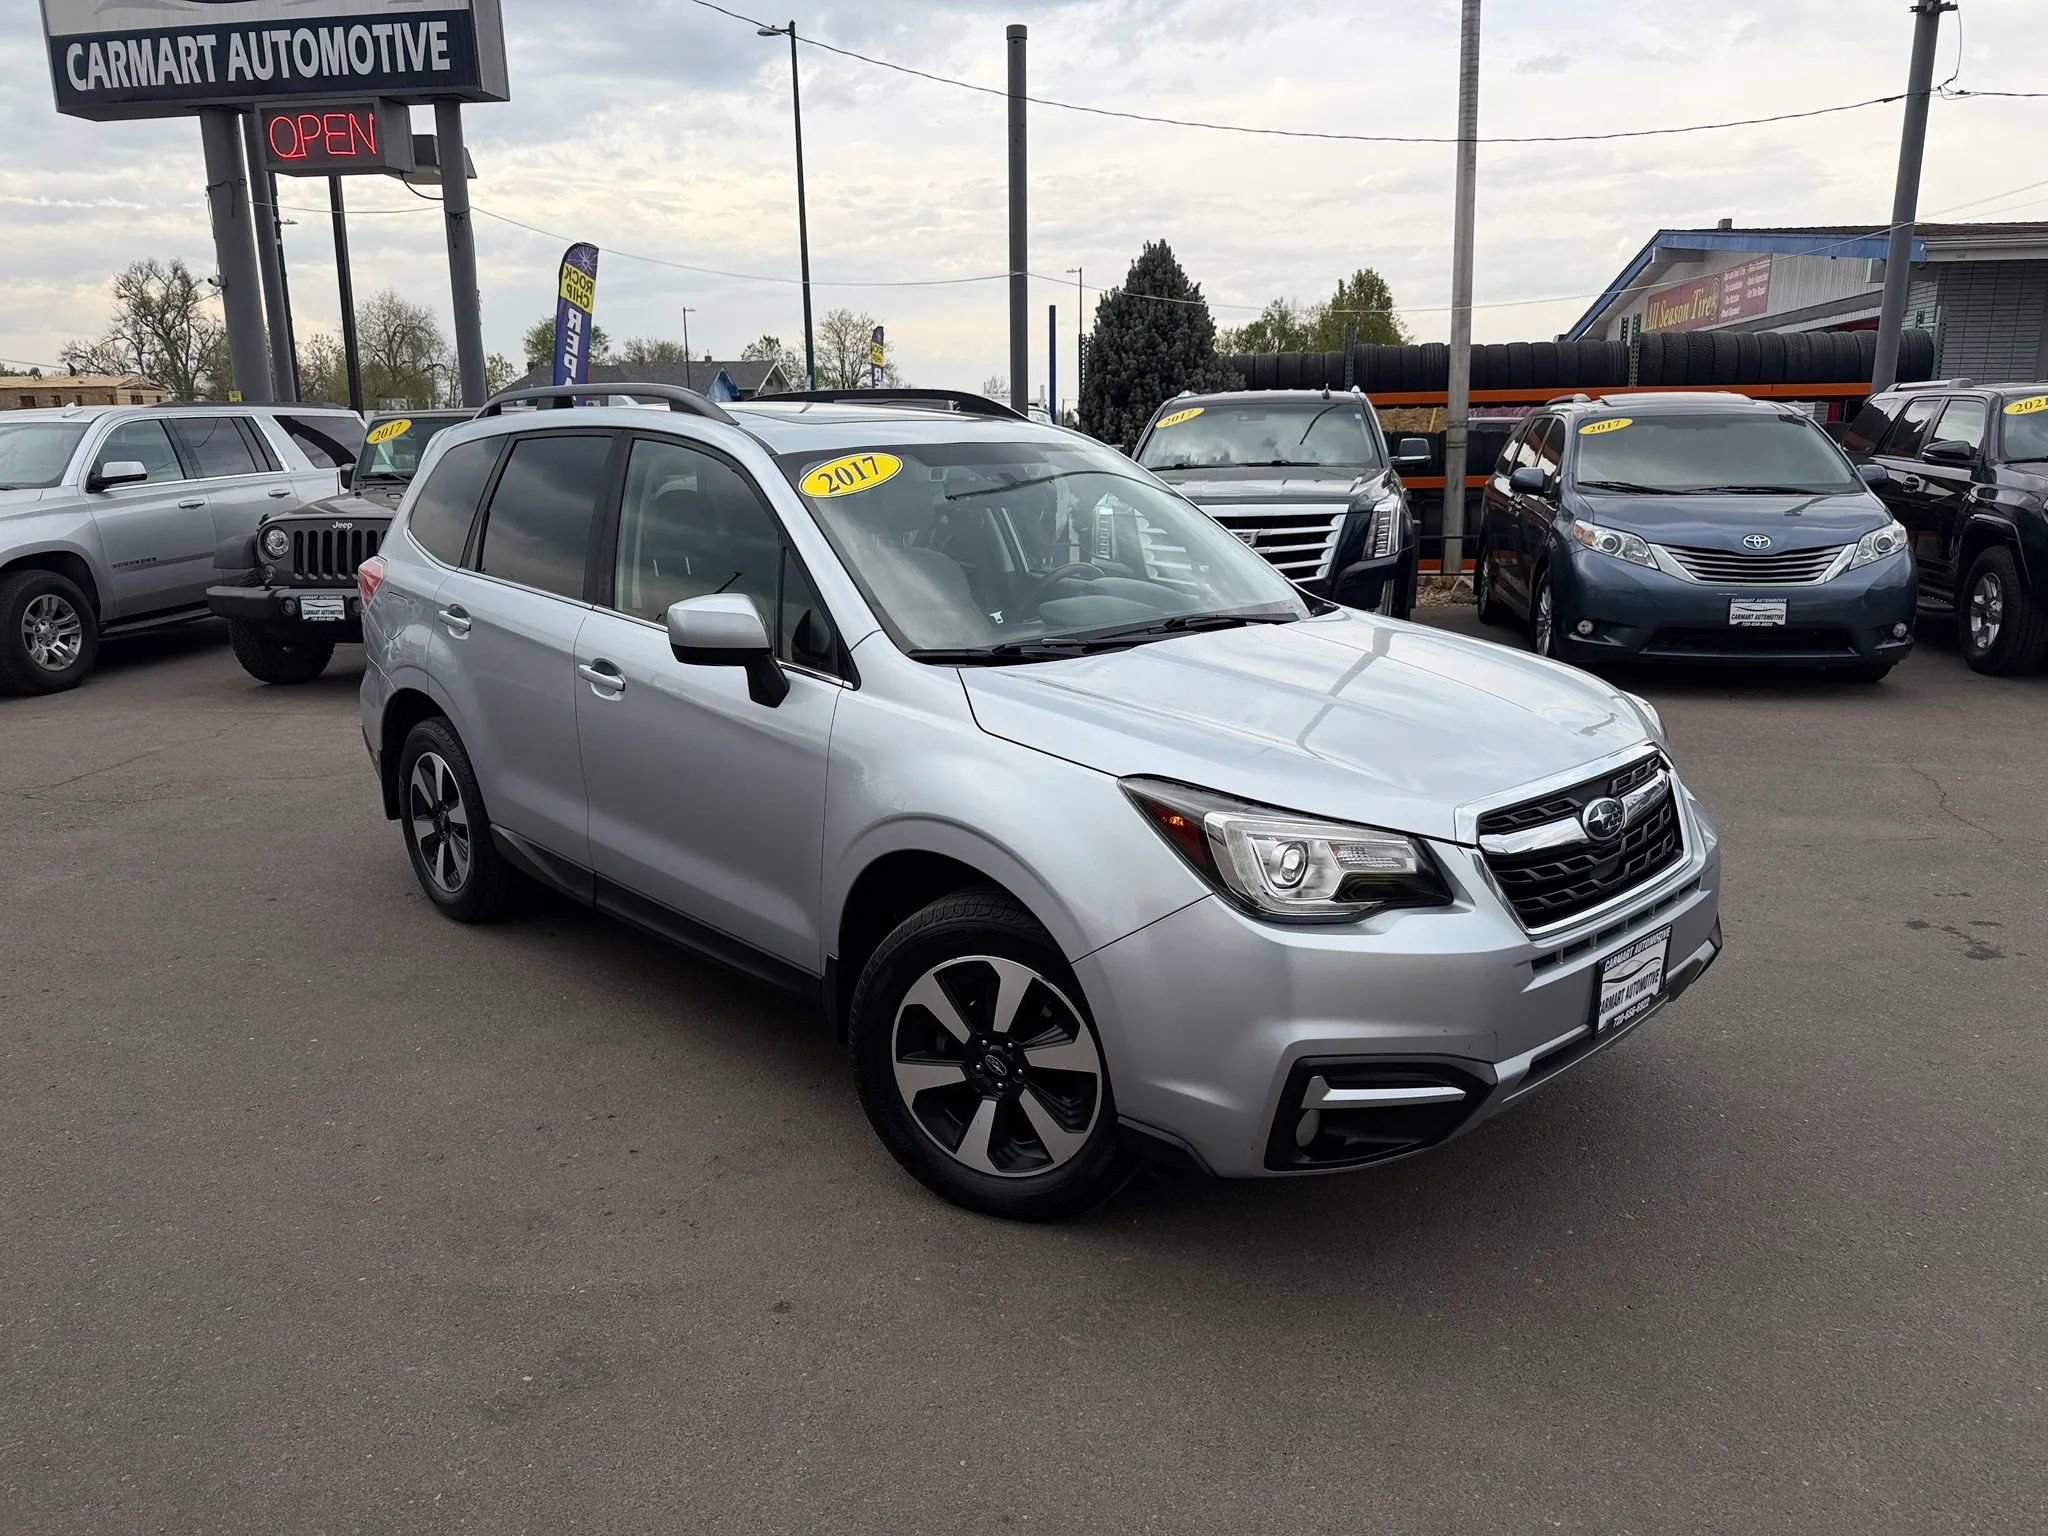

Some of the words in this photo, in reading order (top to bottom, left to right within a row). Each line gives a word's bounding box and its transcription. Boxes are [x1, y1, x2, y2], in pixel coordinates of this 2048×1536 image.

[66, 33, 217, 91] CARMART
[227, 21, 451, 82] AUTOMOTIVE
[269, 112, 376, 158] OPEN
[1658, 300, 1690, 328] Season
[374, 421, 403, 442] 2017
[1165, 410, 1194, 425] 2017
[1590, 420, 1621, 432] 2017
[818, 456, 878, 493] 2017
[332, 521, 353, 530] Jeep
[1754, 613, 1785, 621] AUTOMOTIVE
[1605, 946, 1635, 970] CARMART
[1634, 926, 1672, 955] AUTOMOTIVE
[1600, 988, 1626, 1016] ARMART
[1625, 968, 1661, 1002] AUTOMOTIVE
